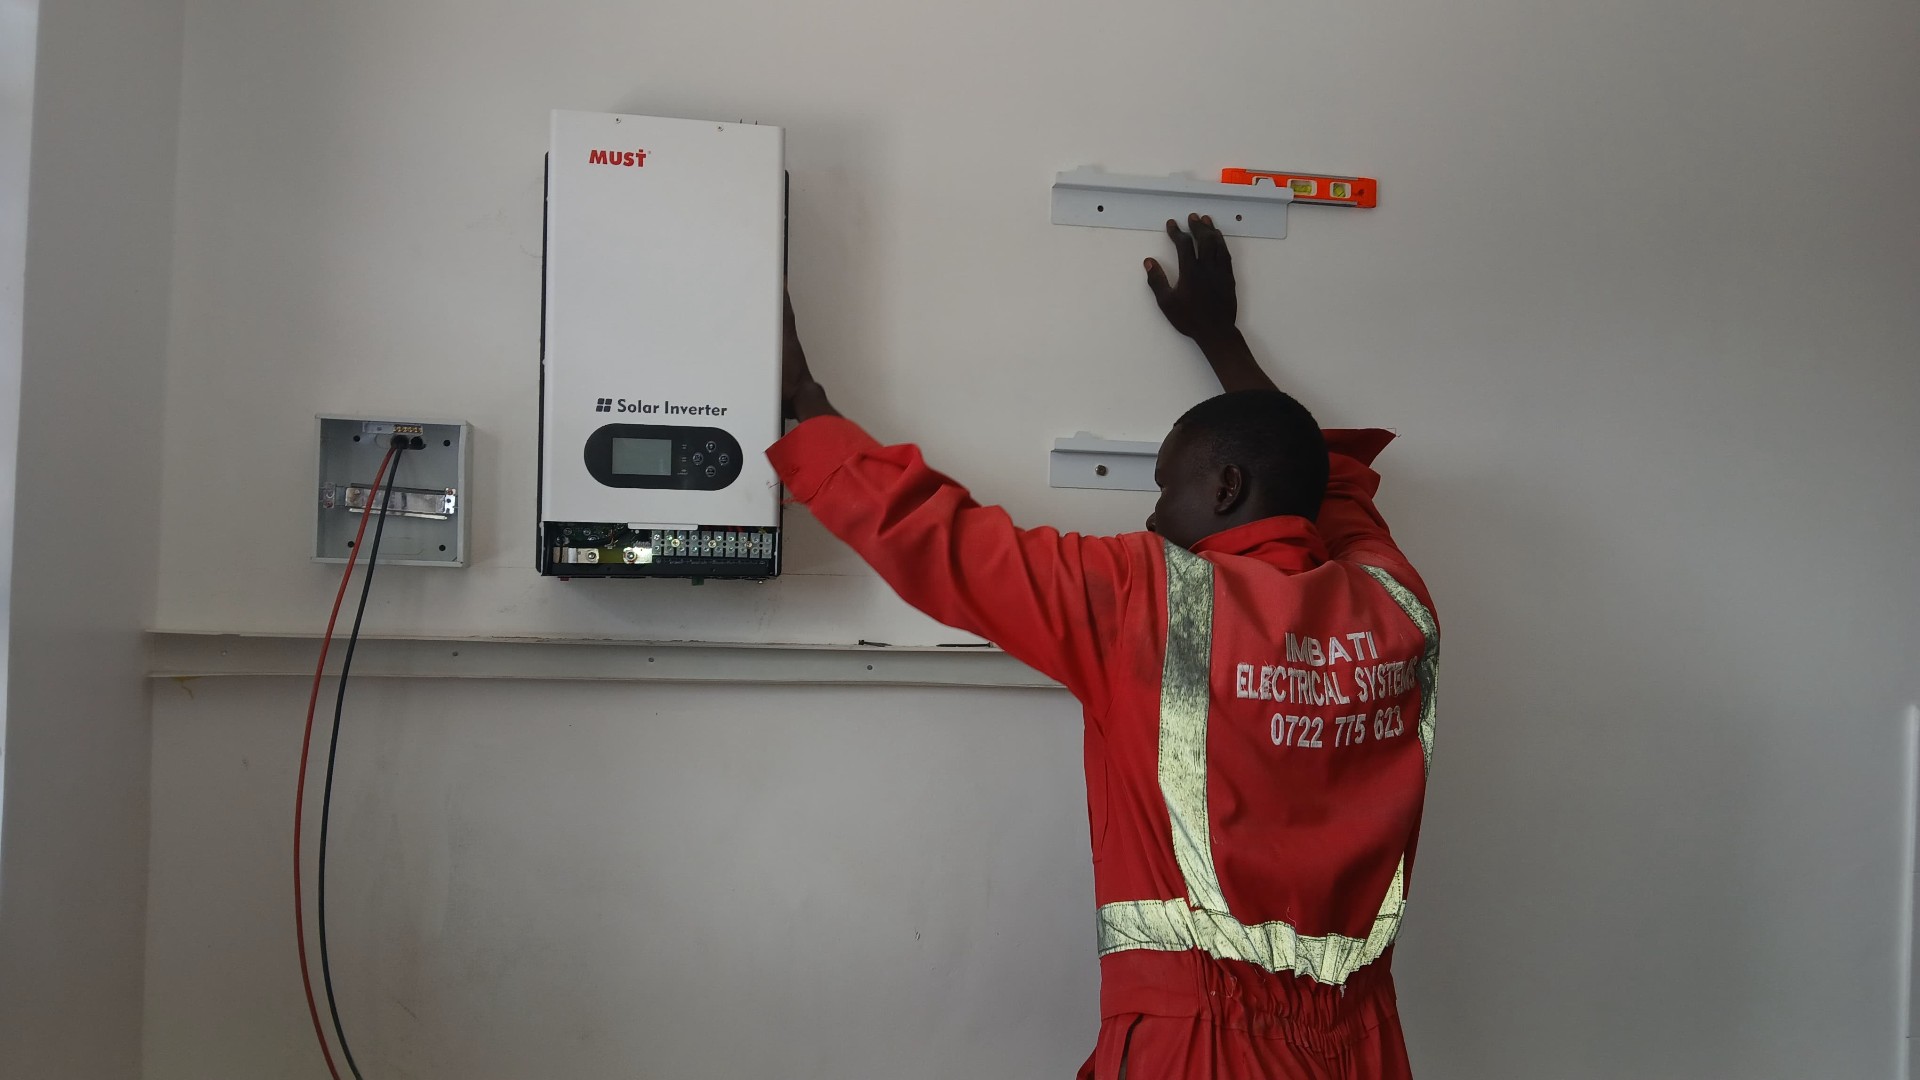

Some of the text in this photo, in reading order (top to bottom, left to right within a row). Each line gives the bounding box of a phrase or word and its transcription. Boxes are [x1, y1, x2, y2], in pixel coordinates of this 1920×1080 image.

[589, 149, 647, 167] MUST
[617, 399, 728, 416] Solar Inverter
[1285, 631, 1379, 667] IMBATI
[1236, 656, 1419, 706] ELECTRICAL SYSTEMS
[1270, 705, 1404, 748] 0722 775 623
